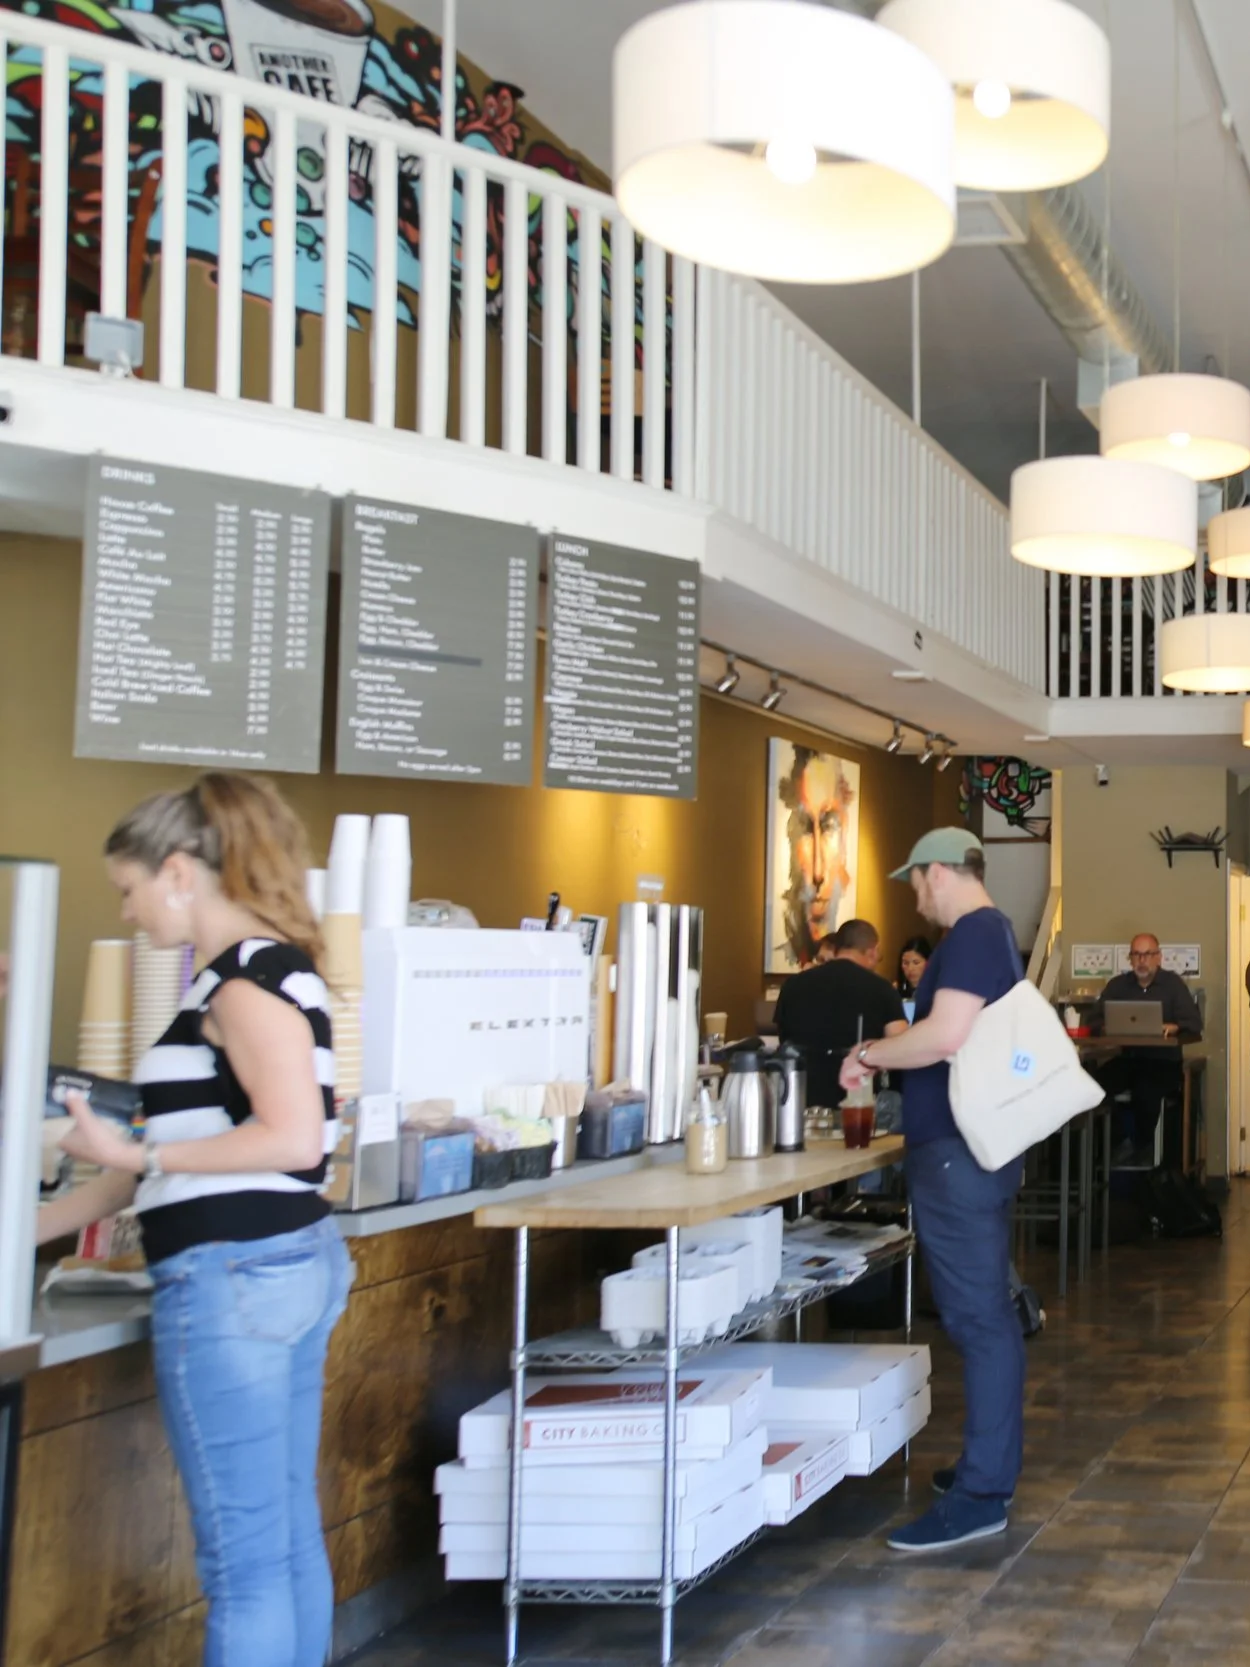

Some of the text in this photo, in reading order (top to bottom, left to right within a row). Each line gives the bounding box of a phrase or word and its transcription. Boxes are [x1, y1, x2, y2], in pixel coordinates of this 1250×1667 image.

[259, 51, 328, 73] ANOTHER
[354, 503, 419, 526] BREAKFAST
[555, 540, 588, 557] LUNCH
[541, 1426, 577, 1441] CITY
[579, 1423, 648, 1439] BAKING
